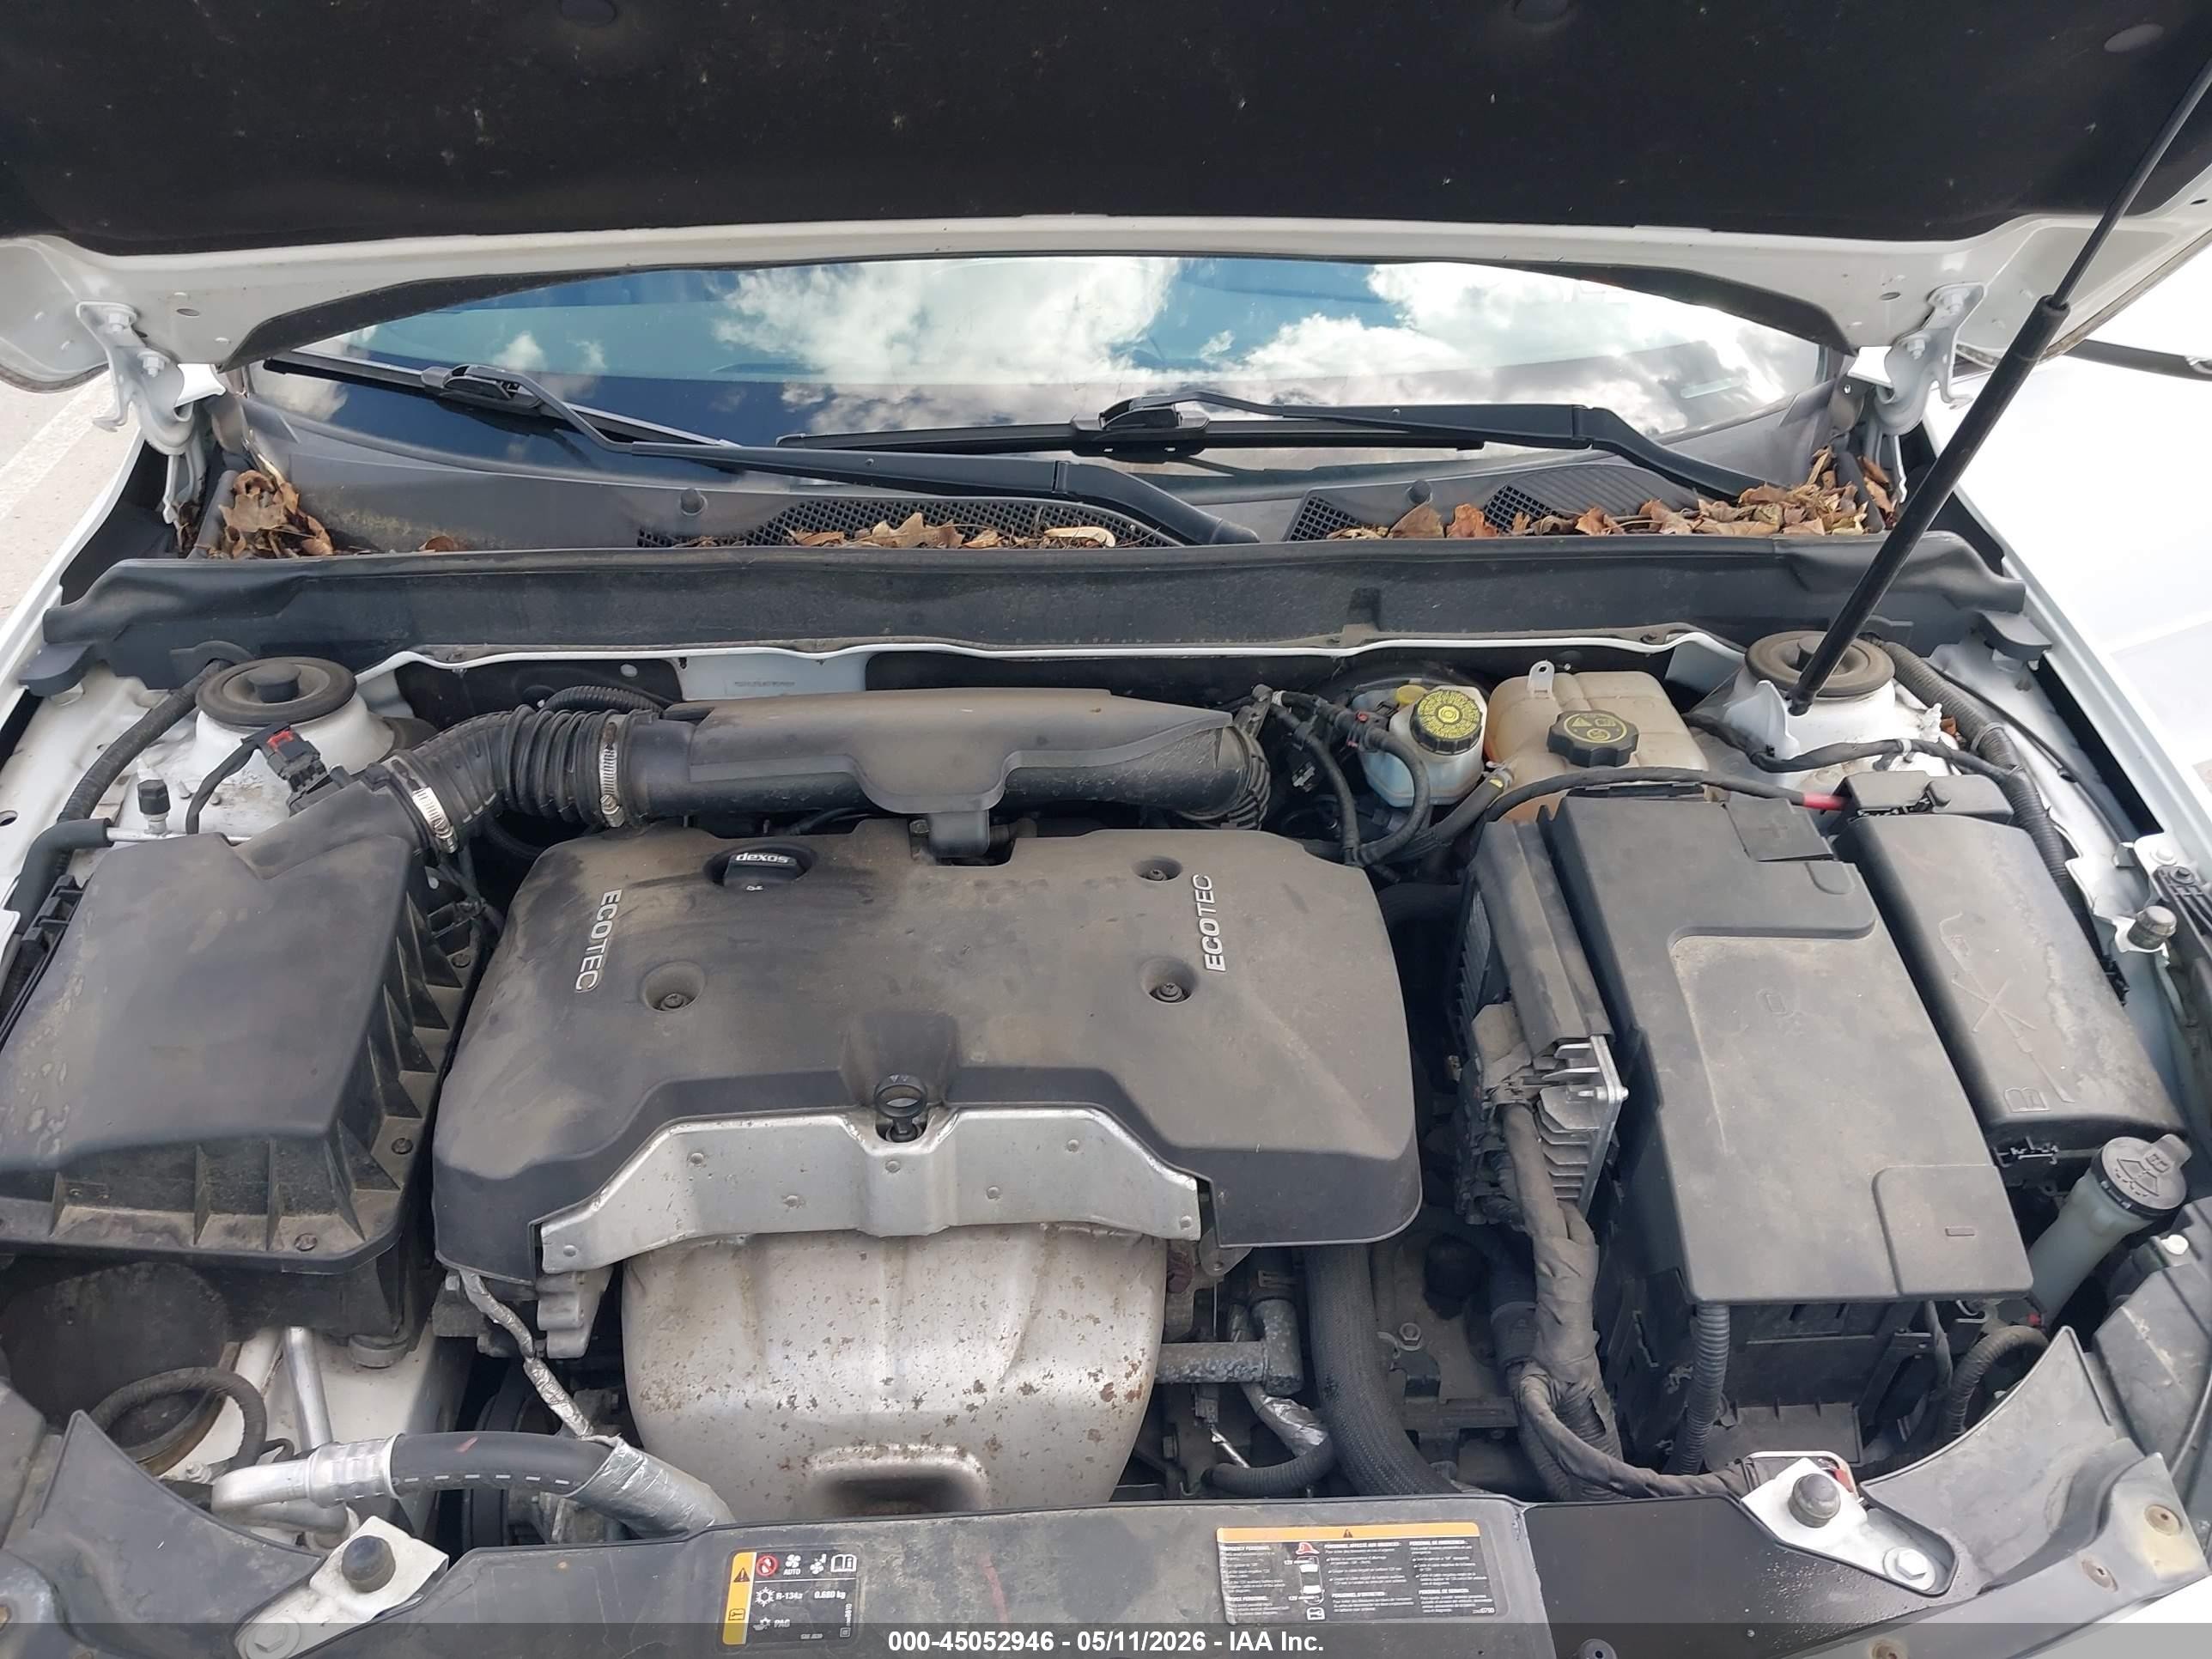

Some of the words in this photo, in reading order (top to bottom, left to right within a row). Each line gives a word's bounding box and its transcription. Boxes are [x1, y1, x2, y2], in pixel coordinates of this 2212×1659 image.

[735, 852, 790, 864] dexos
[574, 889, 623, 992] ECOTEC
[1191, 873, 1227, 973] ECOTEC
[774, 1619, 791, 1628] PAG
